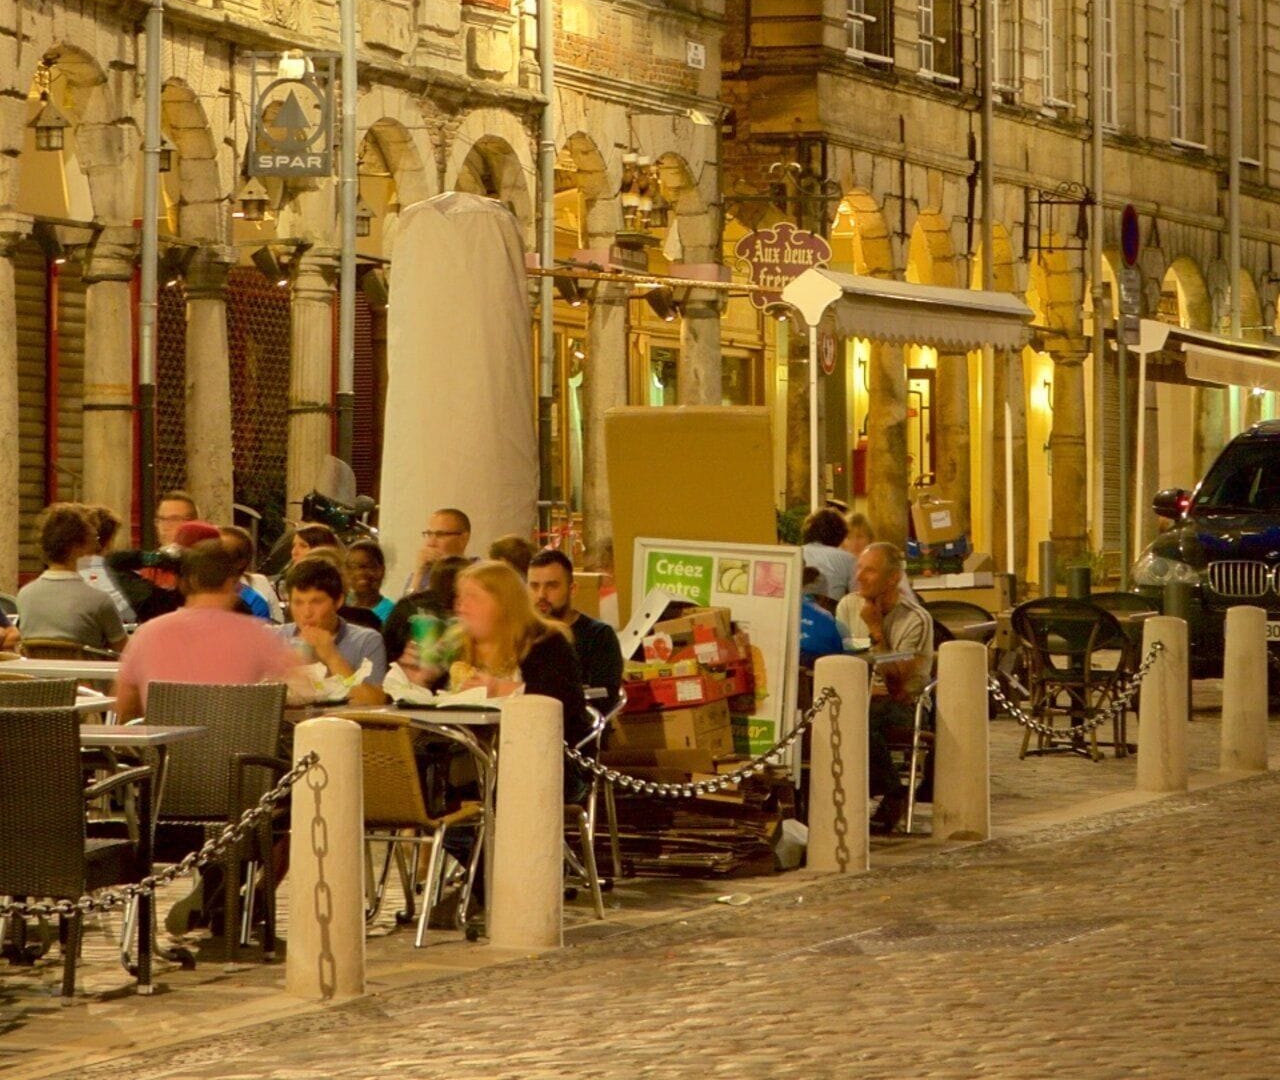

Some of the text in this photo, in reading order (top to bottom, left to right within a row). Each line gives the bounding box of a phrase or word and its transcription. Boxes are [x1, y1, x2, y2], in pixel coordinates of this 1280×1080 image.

[259, 155, 322, 169] SPAR
[752, 240, 814, 265] Aux deux
[759, 266, 797, 289] frèr
[656, 558, 703, 579] Créez
